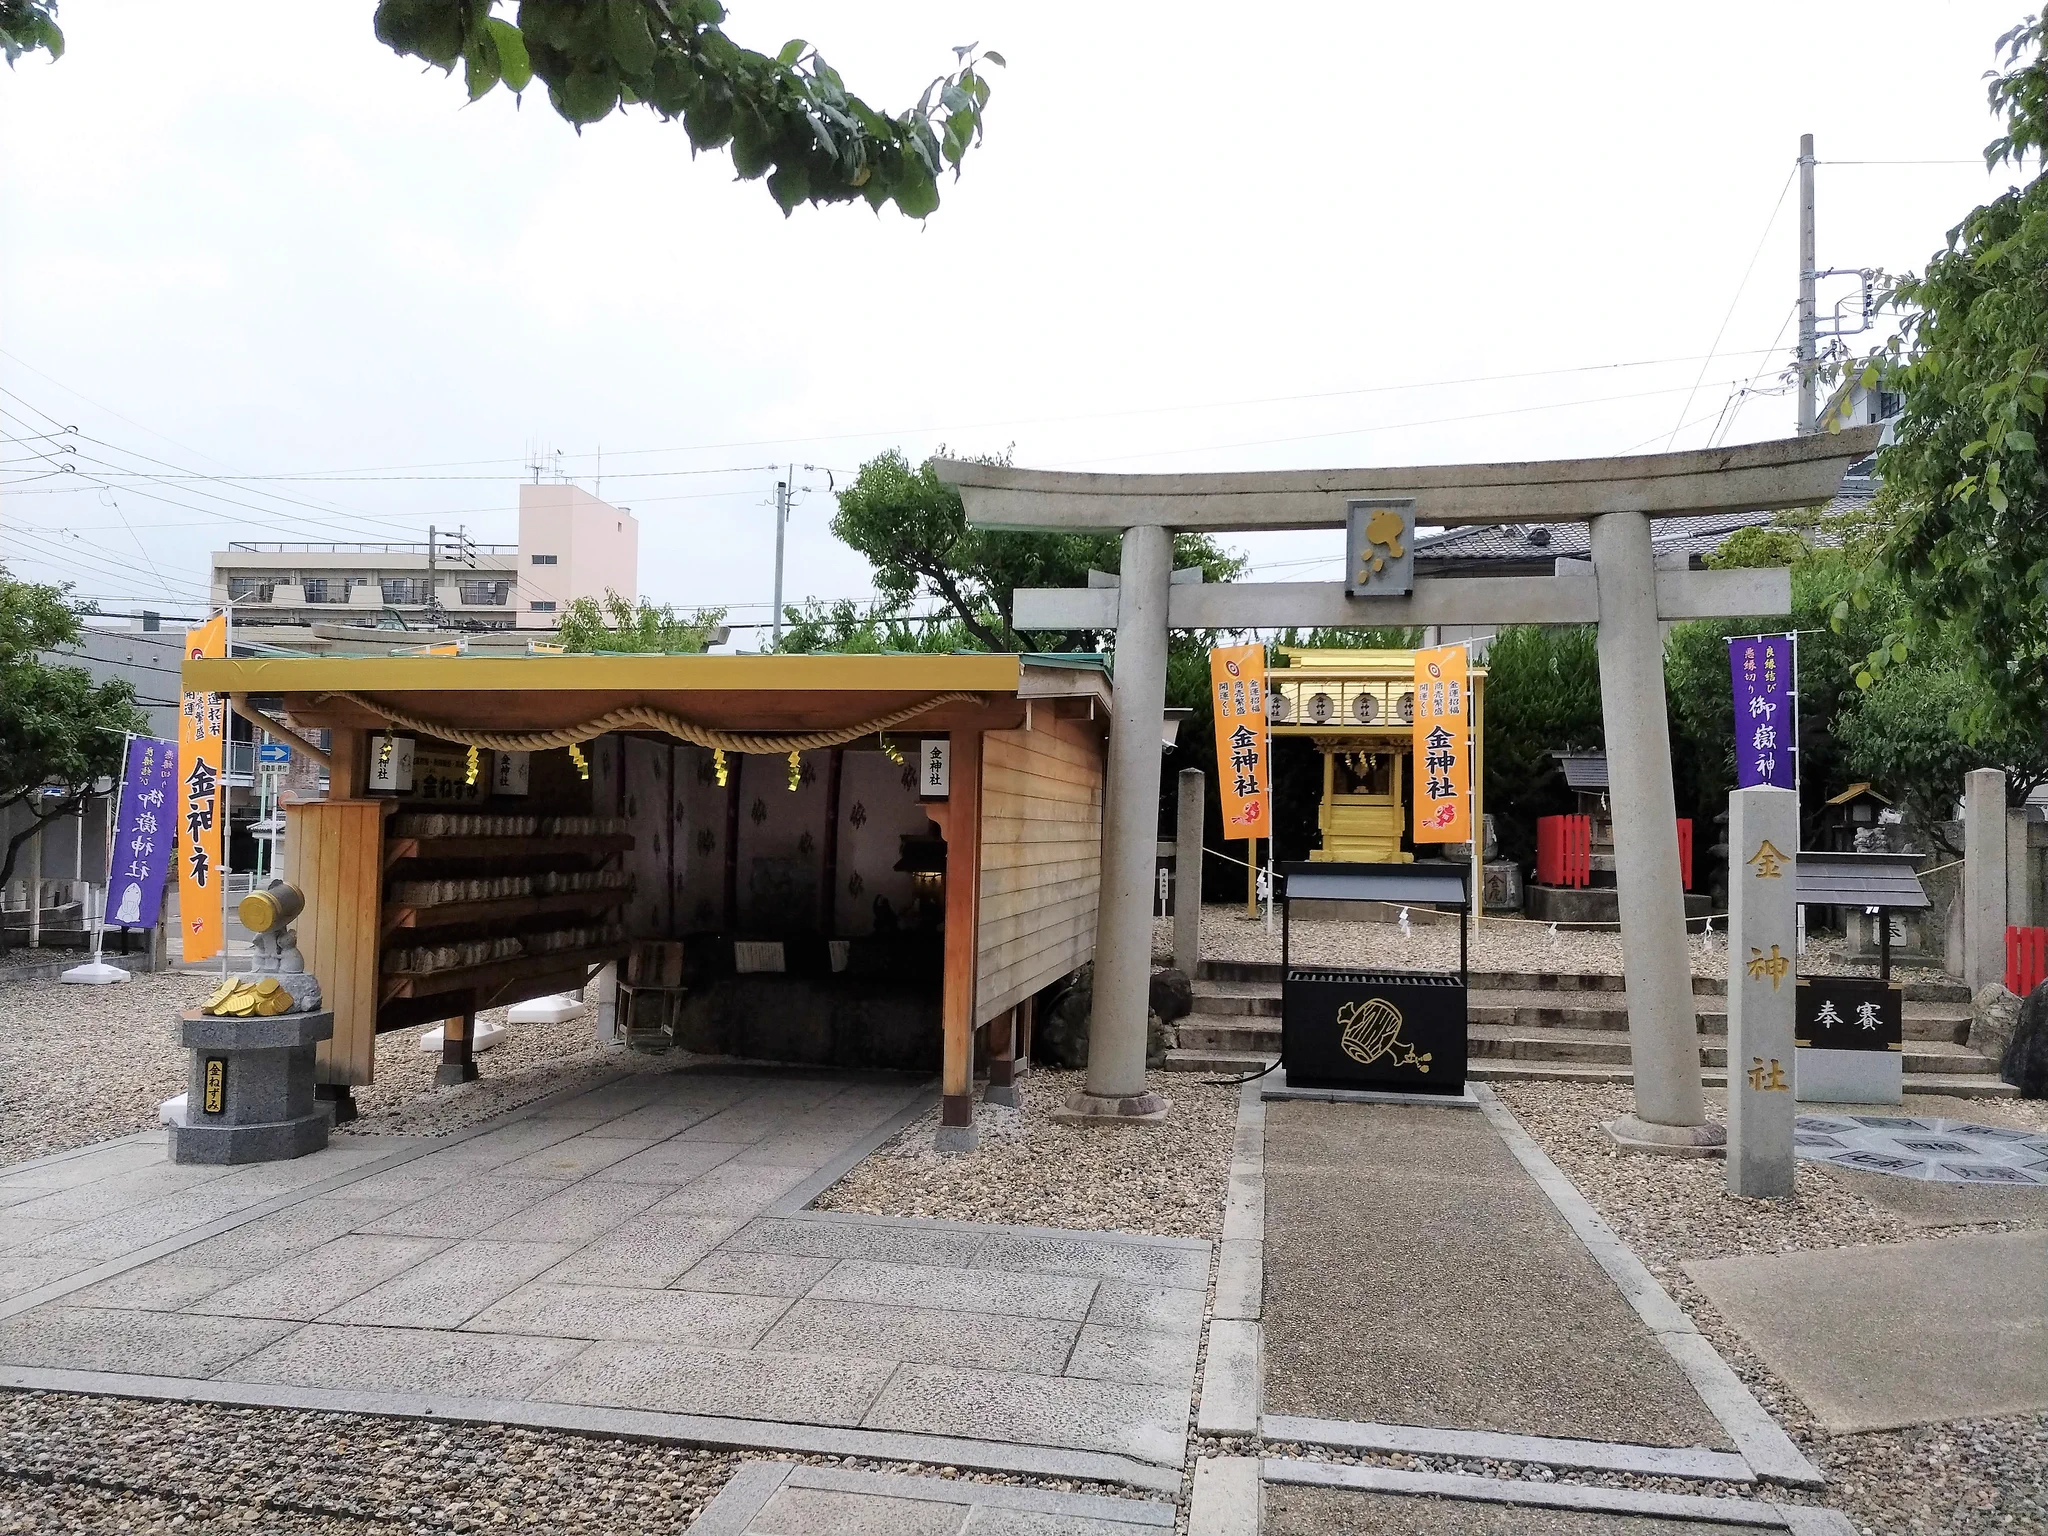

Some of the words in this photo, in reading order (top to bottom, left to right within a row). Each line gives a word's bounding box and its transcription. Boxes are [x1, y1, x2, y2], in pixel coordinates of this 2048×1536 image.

[1744, 647, 1757, 694] 悪縁切り
[1764, 645, 1777, 693] 良縁結び
[1218, 682, 1230, 717] 開運くじ
[1234, 680, 1246, 715] 商売繁盛
[1249, 679, 1261, 713] 金運招福
[1271, 697, 1284, 717] 金神社
[1316, 696, 1326, 717] 金神社
[1360, 696, 1370, 717] 金神社
[1419, 682, 1429, 717] 開運くじ
[1433, 681, 1444, 716] 商売繁盛
[1448, 680, 1460, 715] 金運招福
[1748, 694, 1777, 787] 御嶽神
[500, 753, 511, 787] 金神社
[929, 746, 943, 786] 金神社
[1229, 724, 1261, 798] 金神社
[1425, 725, 1459, 800] 金神社
[1746, 839, 1791, 1093] 金神社
[207, 1063, 222, 1110] 金ねずみ
